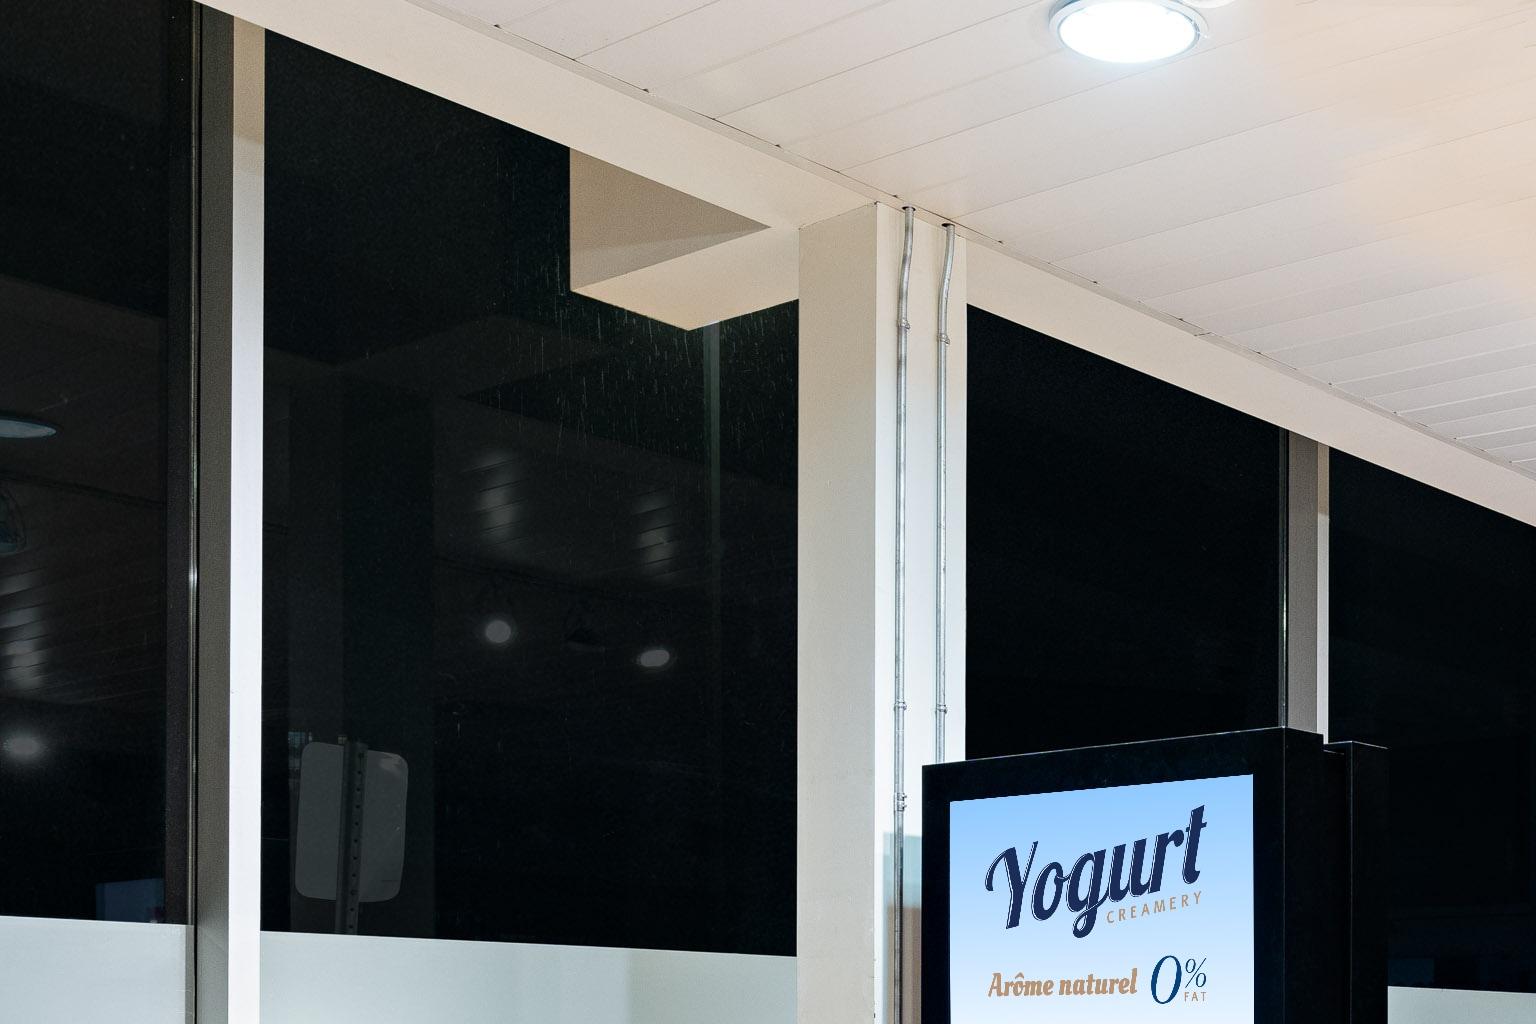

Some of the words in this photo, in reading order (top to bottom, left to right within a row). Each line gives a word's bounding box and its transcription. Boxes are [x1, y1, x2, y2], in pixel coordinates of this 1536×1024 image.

[985, 805, 1207, 938] Yogurt
[1106, 891, 1202, 924] CREAMERY
[988, 972, 1053, 998] Arôme
[1059, 968, 1138, 996] naturel
[1150, 955, 1207, 1005] 0%
[1184, 991, 1207, 1002] FAT
